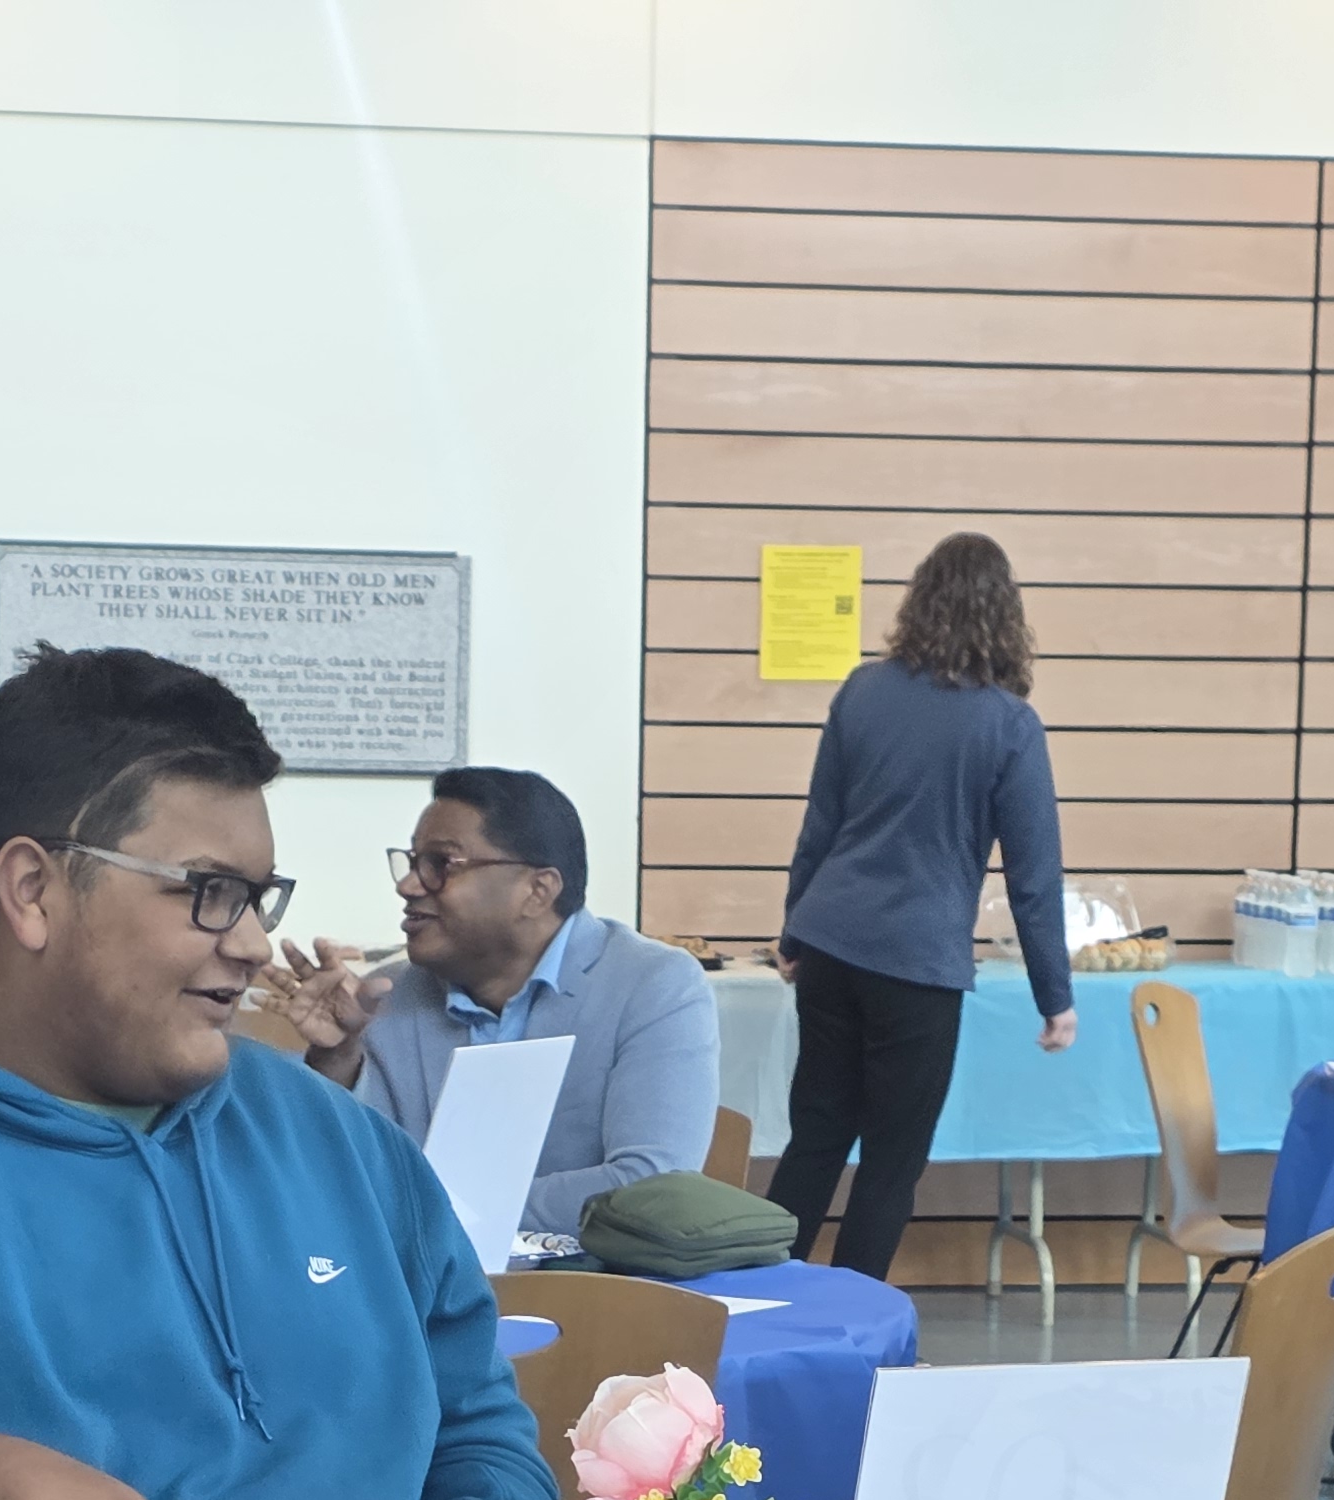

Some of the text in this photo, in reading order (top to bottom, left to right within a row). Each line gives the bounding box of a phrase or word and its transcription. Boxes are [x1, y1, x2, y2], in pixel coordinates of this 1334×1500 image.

[50, 563, 132, 581] SOCIETY
[138, 566, 205, 582] GROWS
[211, 568, 276, 585] GREAT
[282, 570, 341, 587] WHEN
[347, 572, 387, 588] OLD
[393, 573, 437, 589] MEN
[30, 581, 429, 607] PLANT TREES WHOSE SHADE THEY KNOW
[97, 602, 148, 618] THEY
[154, 603, 217, 620] SHALL
[224, 605, 289, 622] NEVER
[296, 608, 327, 624] SIT
[226, 651, 263, 665] Clark
[327, 655, 366, 667] thank
[370, 656, 392, 668] the
[396, 657, 446, 670] student
[249, 668, 298, 680] Student
[352, 670, 377, 682] and
[381, 670, 403, 682] the
[408, 670, 446, 683] Board
